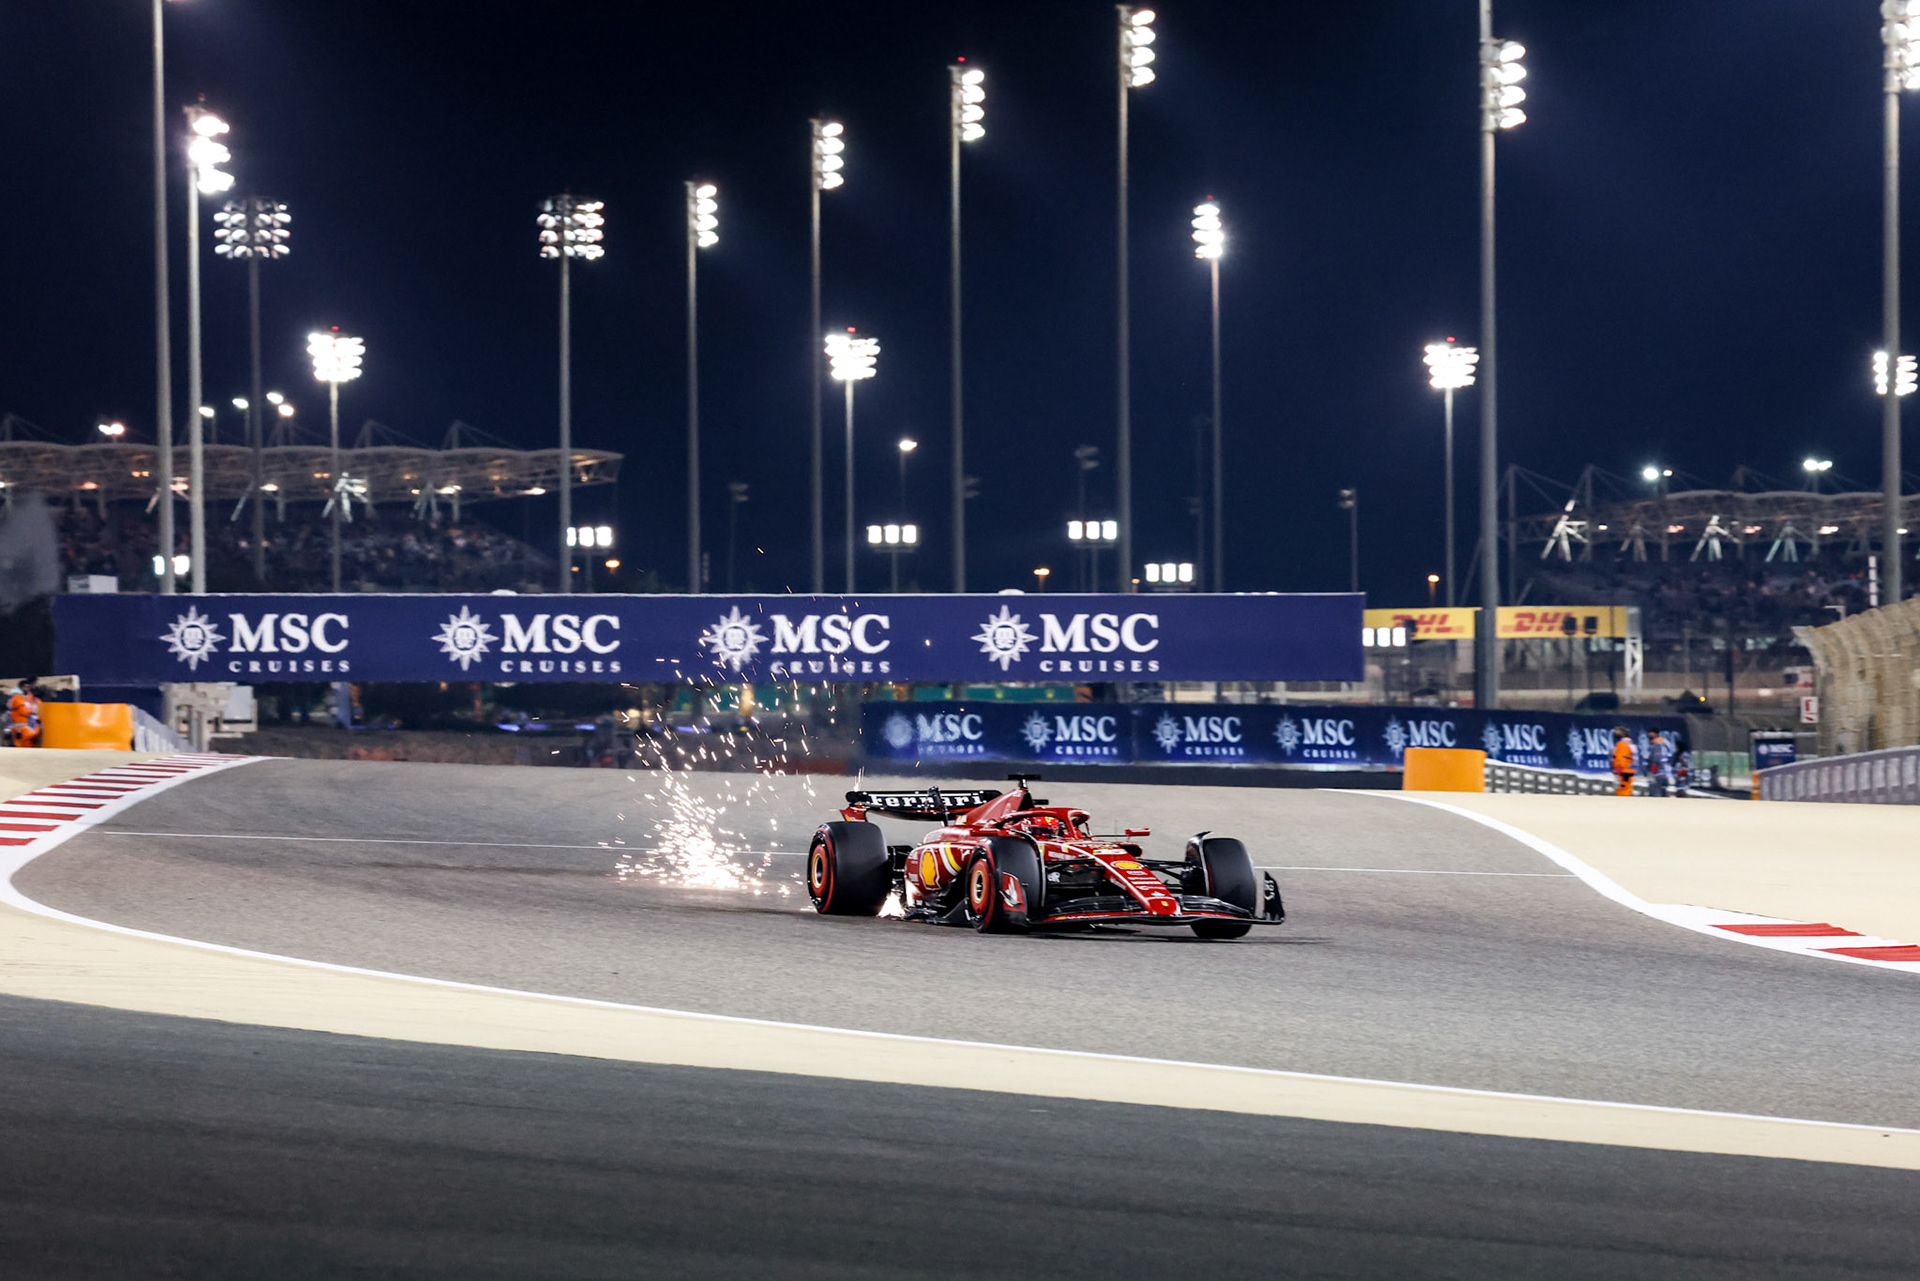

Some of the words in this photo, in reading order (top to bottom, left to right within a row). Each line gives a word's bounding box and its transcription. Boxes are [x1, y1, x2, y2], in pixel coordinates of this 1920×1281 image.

[228, 613, 349, 653] MSC
[500, 614, 621, 654] MSC
[770, 614, 890, 654] MSC
[1039, 613, 1159, 653] MSC
[1514, 612, 1577, 632] DH
[228, 660, 350, 672] CRUISES
[500, 660, 621, 673] CRUISES
[770, 660, 891, 674] CRUISES
[1039, 660, 1160, 672] CRUISES
[917, 714, 983, 742] MSC
[1055, 715, 1117, 742] MSC
[1184, 716, 1242, 743] MSC
[1302, 718, 1355, 746] MSC
[1408, 720, 1456, 747] MSC
[1502, 723, 1546, 751] MSC
